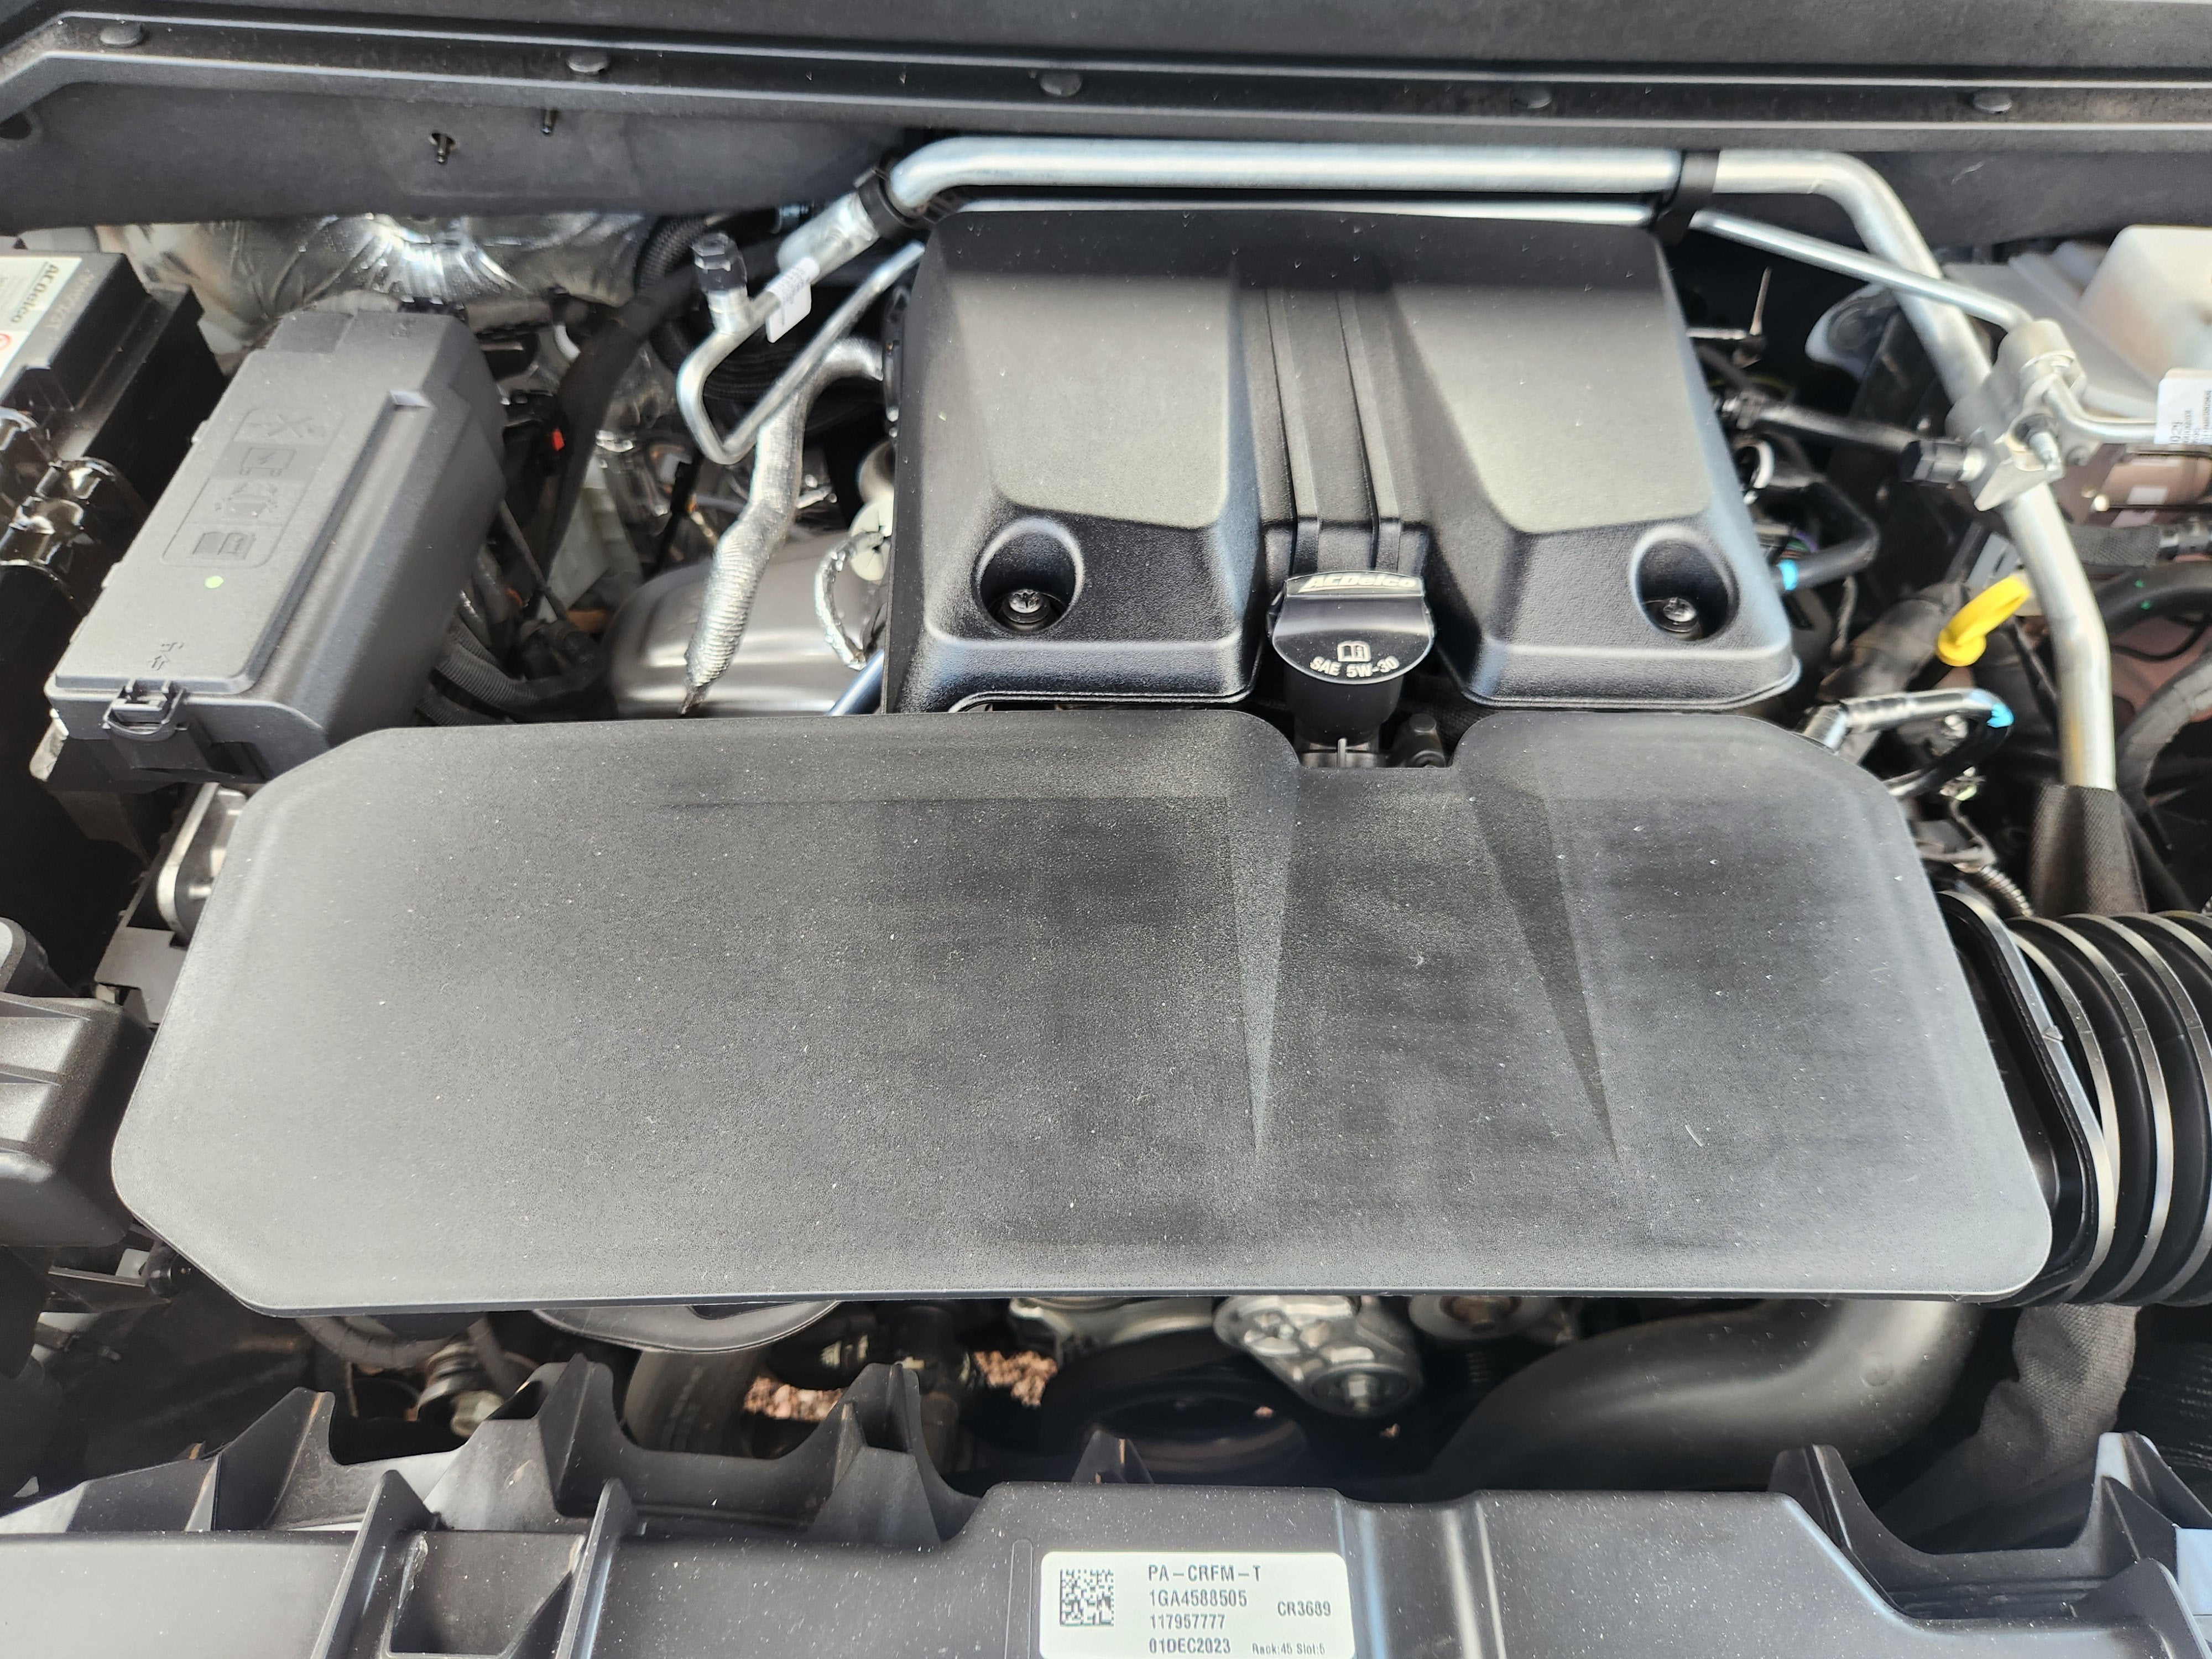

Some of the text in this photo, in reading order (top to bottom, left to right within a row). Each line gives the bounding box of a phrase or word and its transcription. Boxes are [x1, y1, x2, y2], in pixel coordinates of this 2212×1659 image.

[1301, 575, 1416, 591] ACDelco
[1310, 655, 1400, 678] SAE 5W-30
[1149, 1589, 1248, 1607] 1GA4588505
[1277, 1600, 1331, 1616] CR3689
[1150, 1614, 1225, 1630] 117957777
[1149, 1637, 1232, 1655] 01DEC2023
